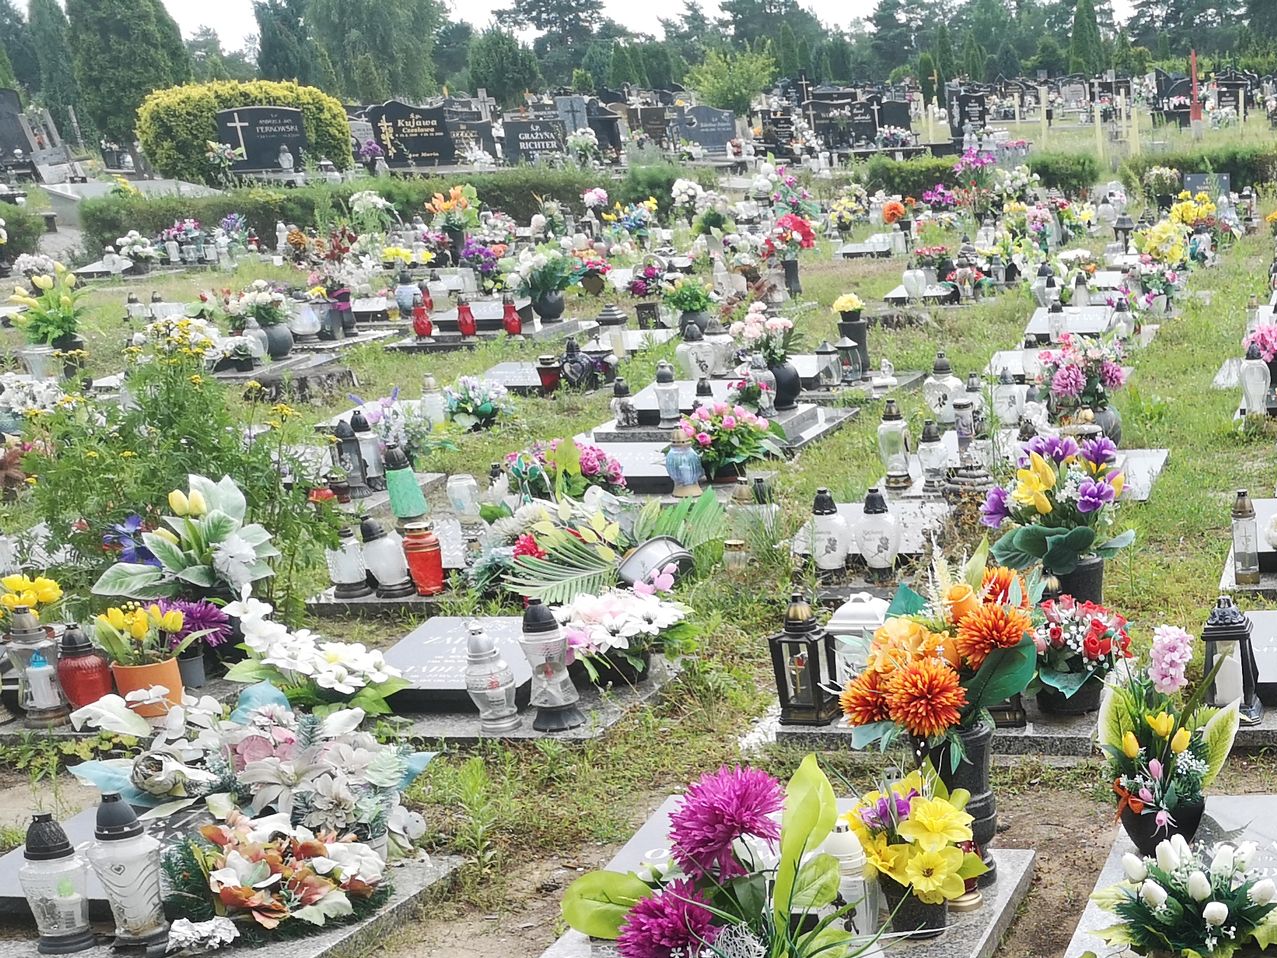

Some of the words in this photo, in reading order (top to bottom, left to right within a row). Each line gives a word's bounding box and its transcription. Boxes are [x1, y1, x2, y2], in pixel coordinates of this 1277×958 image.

[397, 119, 438, 128] Kujawa
[518, 131, 556, 140] GRAŻYNA
[519, 140, 558, 150] RICHTER
